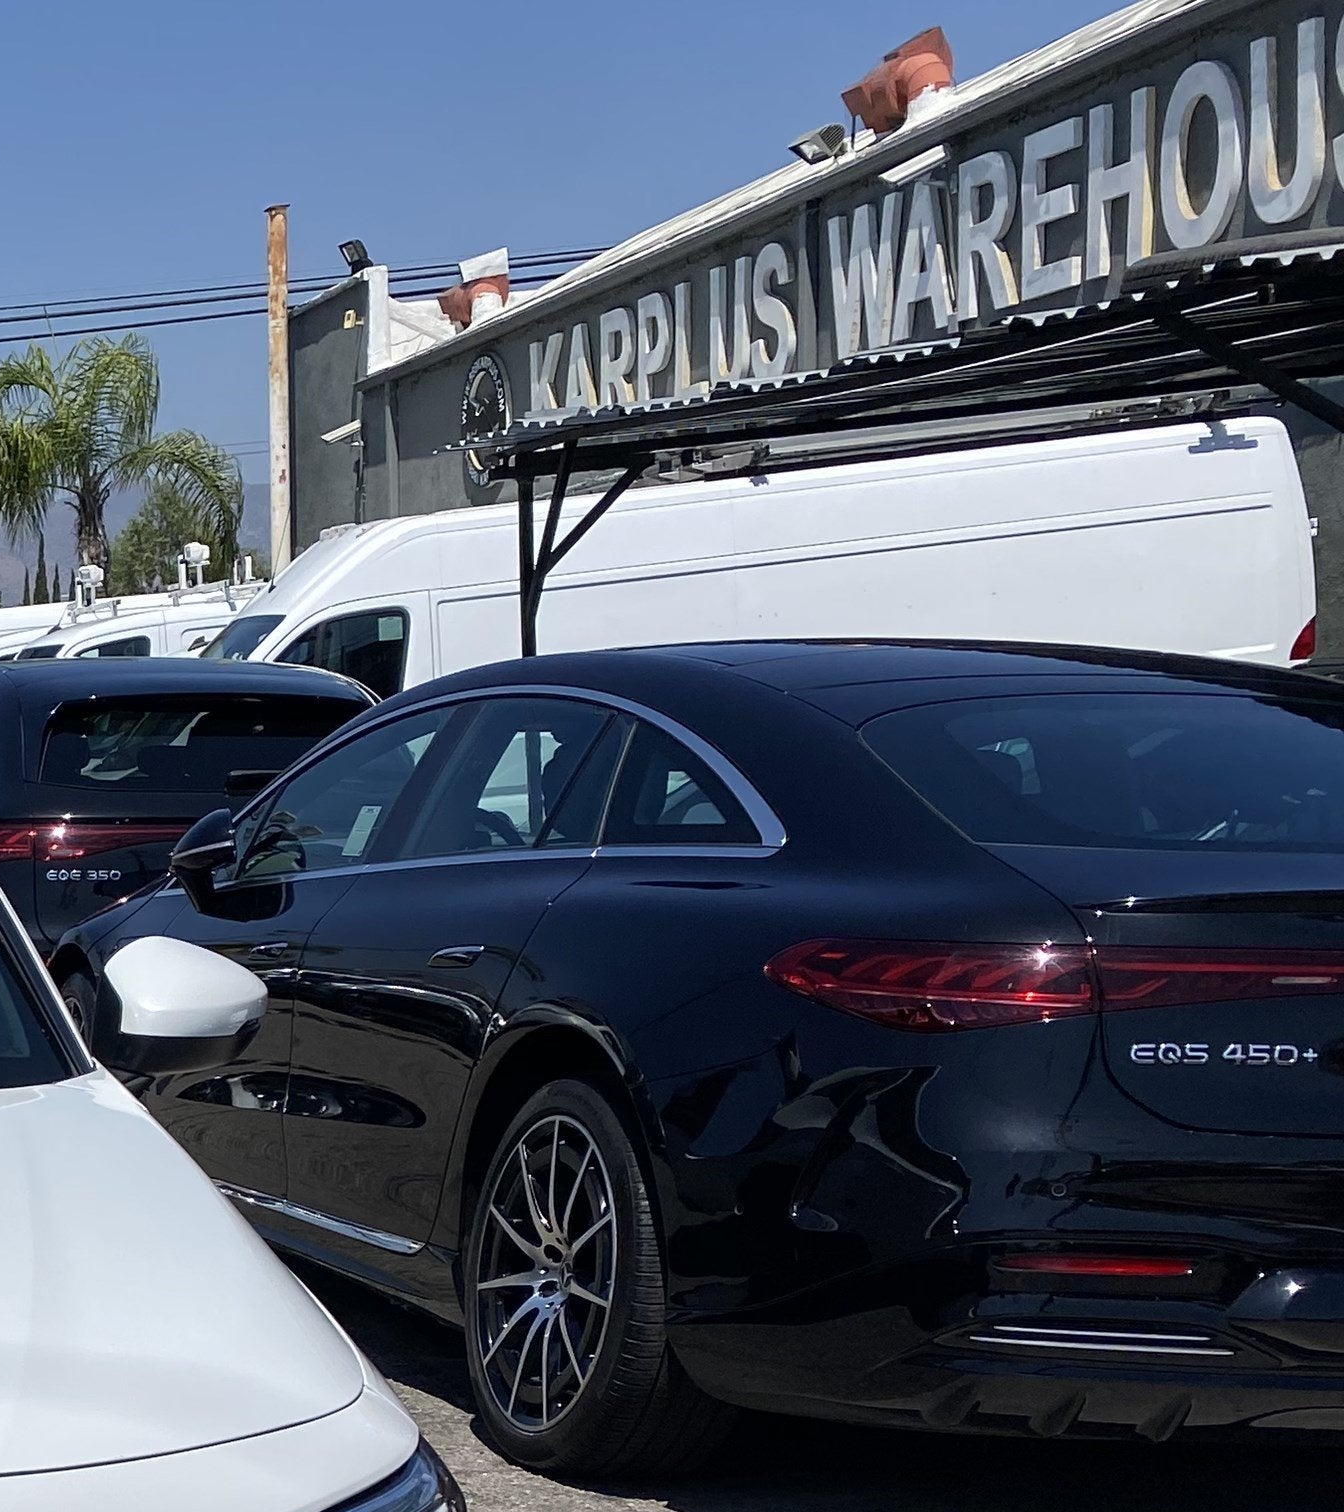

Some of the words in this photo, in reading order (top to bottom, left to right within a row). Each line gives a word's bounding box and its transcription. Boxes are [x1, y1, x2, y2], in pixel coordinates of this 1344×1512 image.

[529, 242, 797, 409] KARPLUS
[827, 12, 1344, 361] WAREHOU
[46, 869, 82, 881] EQE
[86, 869, 121, 881] 350
[1130, 1043, 1209, 1065] EQS
[1222, 1043, 1319, 1066] 450+
